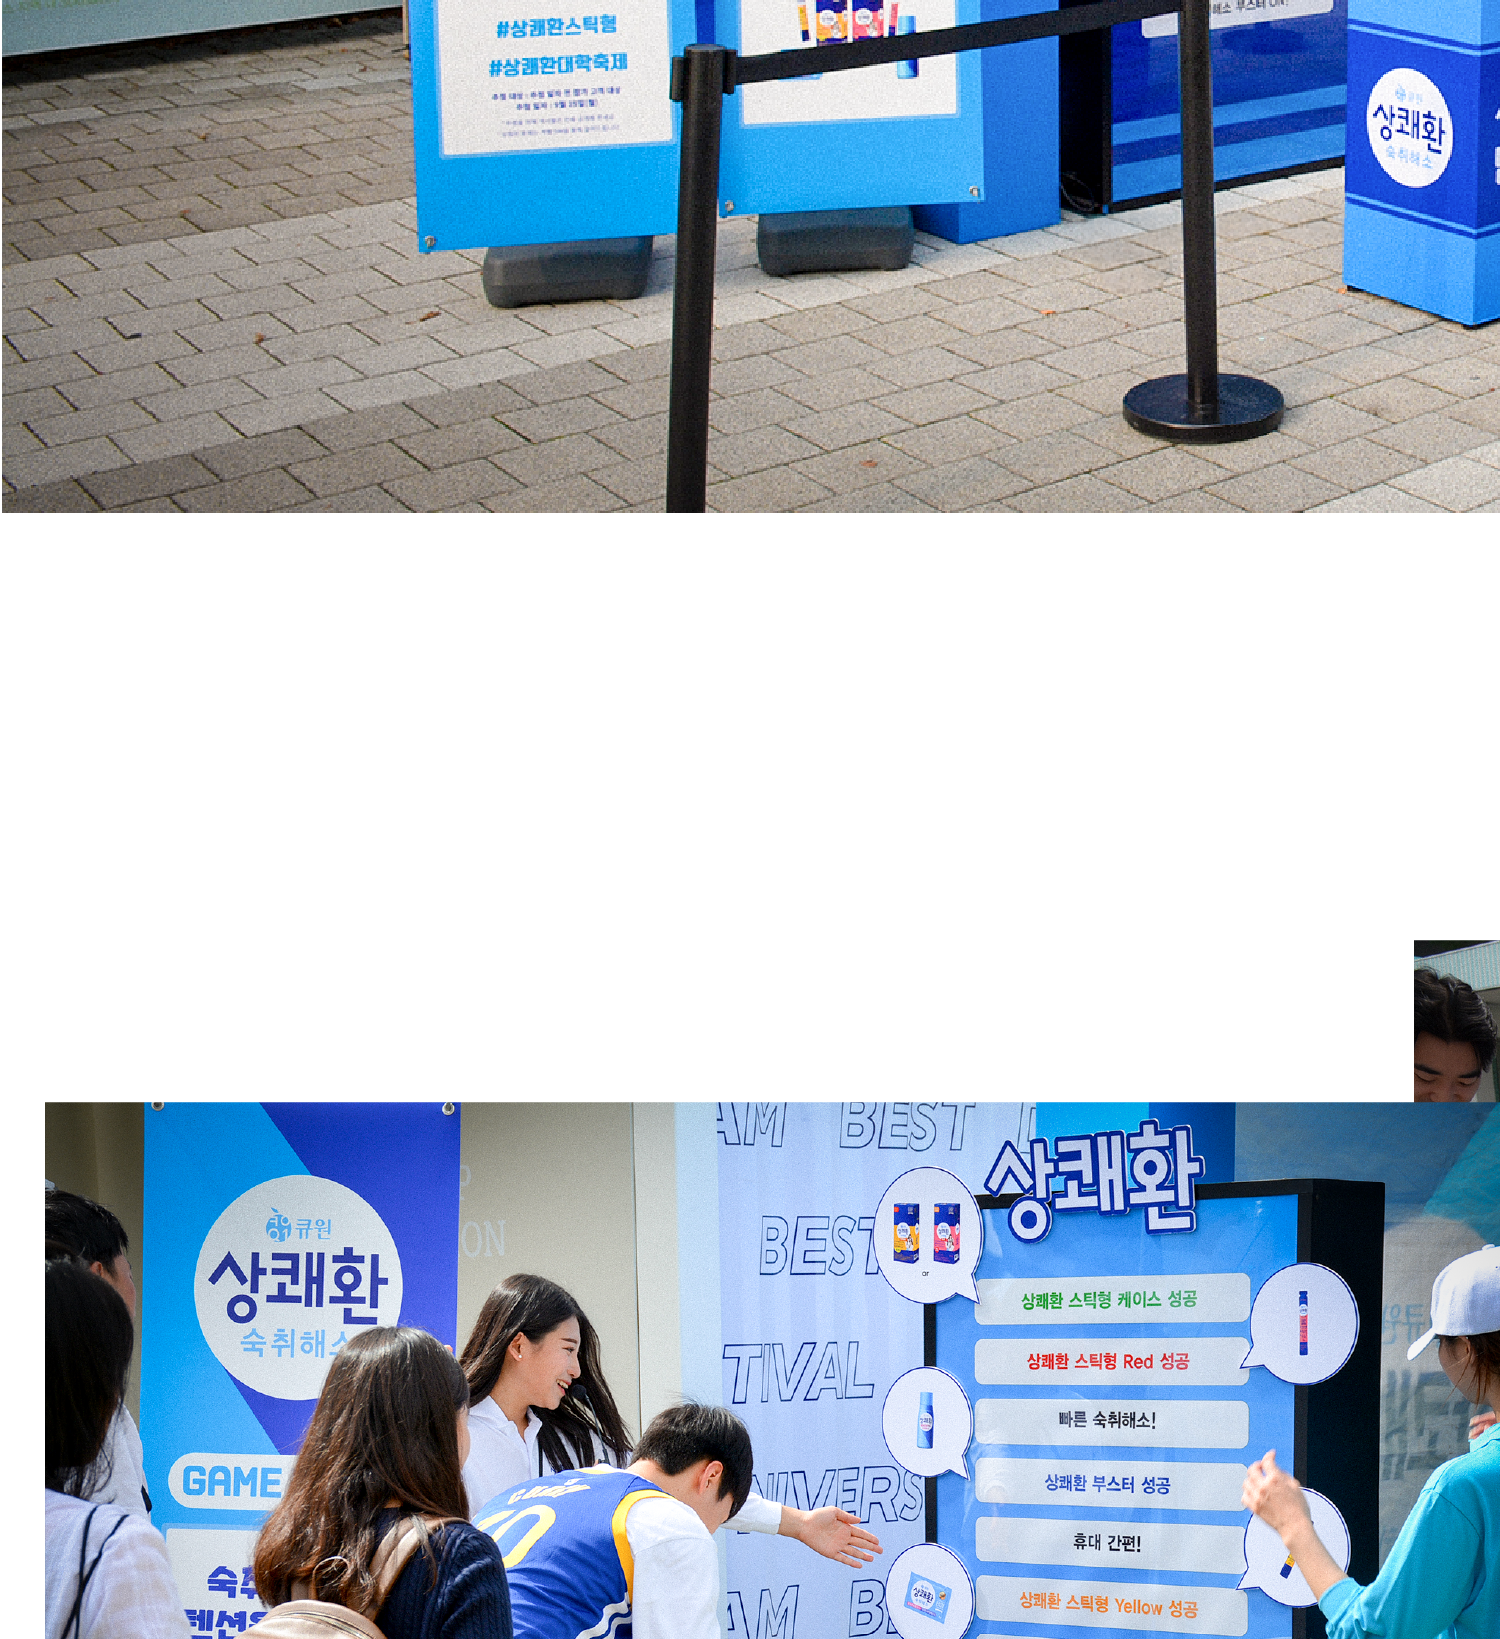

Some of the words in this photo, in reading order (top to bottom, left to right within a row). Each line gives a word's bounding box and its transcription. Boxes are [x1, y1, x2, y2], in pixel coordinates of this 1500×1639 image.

[1372, 103, 1446, 155] 상쾌환
[840, 1102, 976, 1151] BEST
[984, 1118, 1205, 1243] 상쾌환
[295, 1219, 332, 1240] 큐원
[208, 1247, 389, 1325] 상쾌환
[1021, 1292, 1063, 1310] 상쾌환
[1069, 1291, 1112, 1309] 스틱형
[1118, 1291, 1162, 1308] 케이스
[1168, 1290, 1198, 1308] 성공
[723, 1341, 874, 1404] TIVAL
[1027, 1353, 1069, 1370] 상쾌환
[1075, 1353, 1117, 1370] 스틱형
[1124, 1354, 1153, 1369] Red
[1160, 1352, 1190, 1370] 성공
[1059, 1411, 1087, 1428] 빠른
[1093, 1411, 1156, 1429] 숙취해소!
[182, 1466, 281, 1498] GAME
[1045, 1474, 1087, 1491] 상쾌환
[1092, 1476, 1135, 1493] 부스터
[1142, 1477, 1171, 1494] 성공
[1074, 1533, 1101, 1550] 휴대
[1108, 1535, 1141, 1552] 간편!
[1020, 1592, 1061, 1610] 상쾌환
[1066, 1594, 1109, 1612] 스틱형
[1115, 1598, 1162, 1615] Yellow
[1169, 1600, 1198, 1618] 성공
